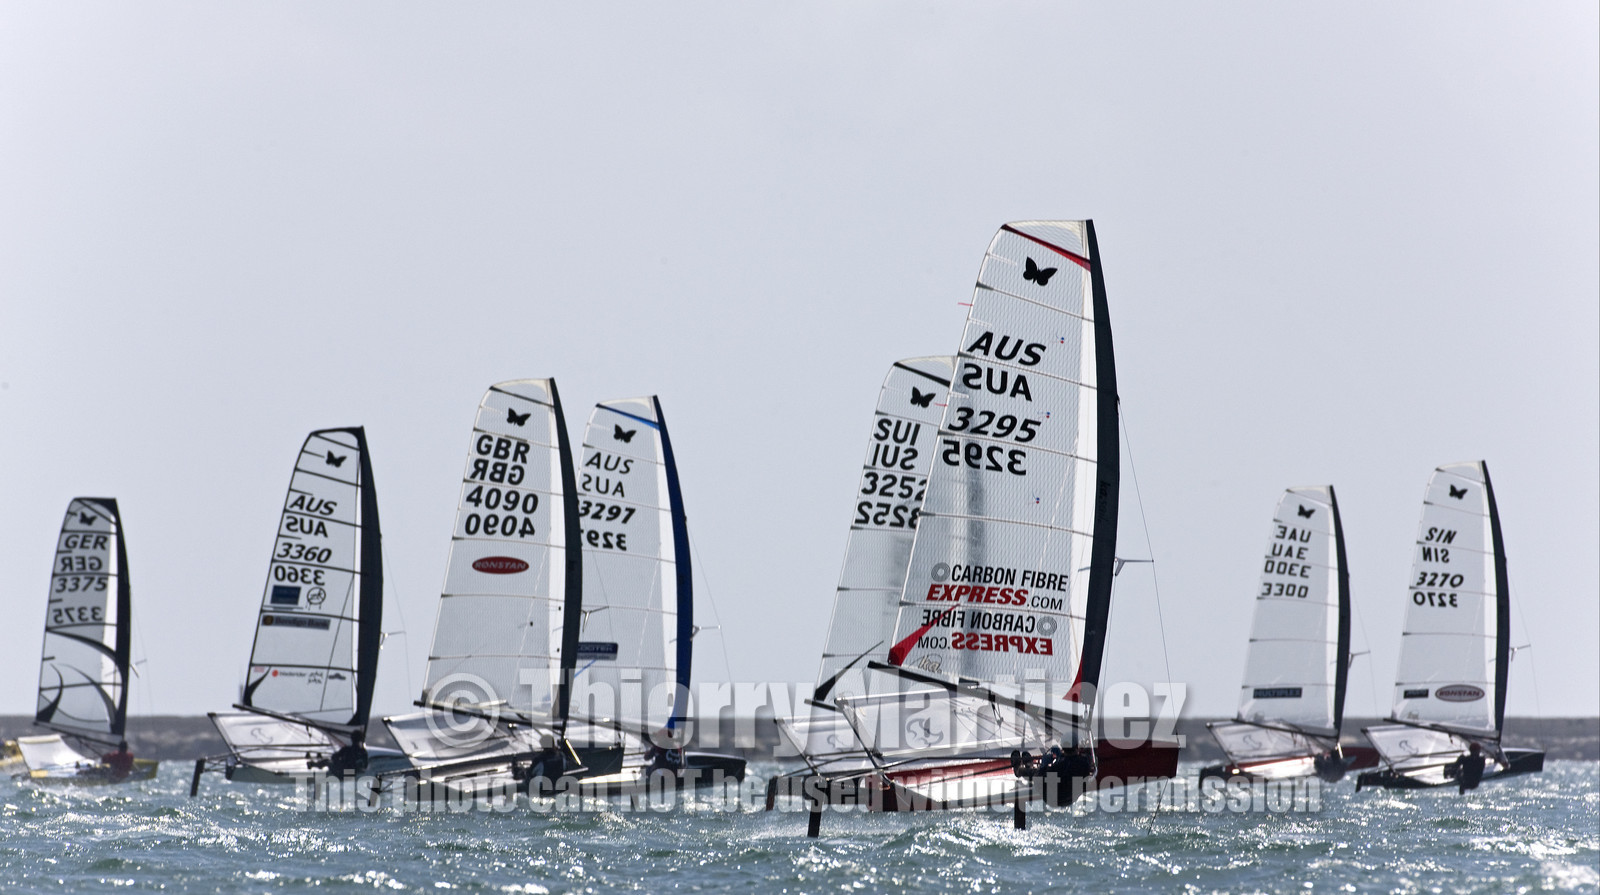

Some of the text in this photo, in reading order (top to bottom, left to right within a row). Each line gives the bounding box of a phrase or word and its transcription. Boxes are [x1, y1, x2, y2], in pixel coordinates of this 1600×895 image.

[966, 331, 1047, 366] AUS
[874, 418, 921, 445] SUI
[948, 406, 1041, 442] 3295
[476, 434, 531, 464] GBR
[585, 452, 634, 474] AUS
[861, 471, 928, 501] 3252
[289, 495, 338, 516] AUS
[465, 485, 539, 515] 4090
[579, 500, 636, 524] 3297
[64, 534, 108, 550] GER
[1425, 527, 1457, 544] SIN
[276, 542, 332, 564] 3360
[1272, 543, 1308, 560] UAE
[474, 560, 526, 570] RONSTAN
[55, 576, 108, 593] 3375
[951, 564, 1068, 591] CARBON FIBRE
[1416, 571, 1464, 588] 3270
[1262, 582, 1309, 598] 3300
